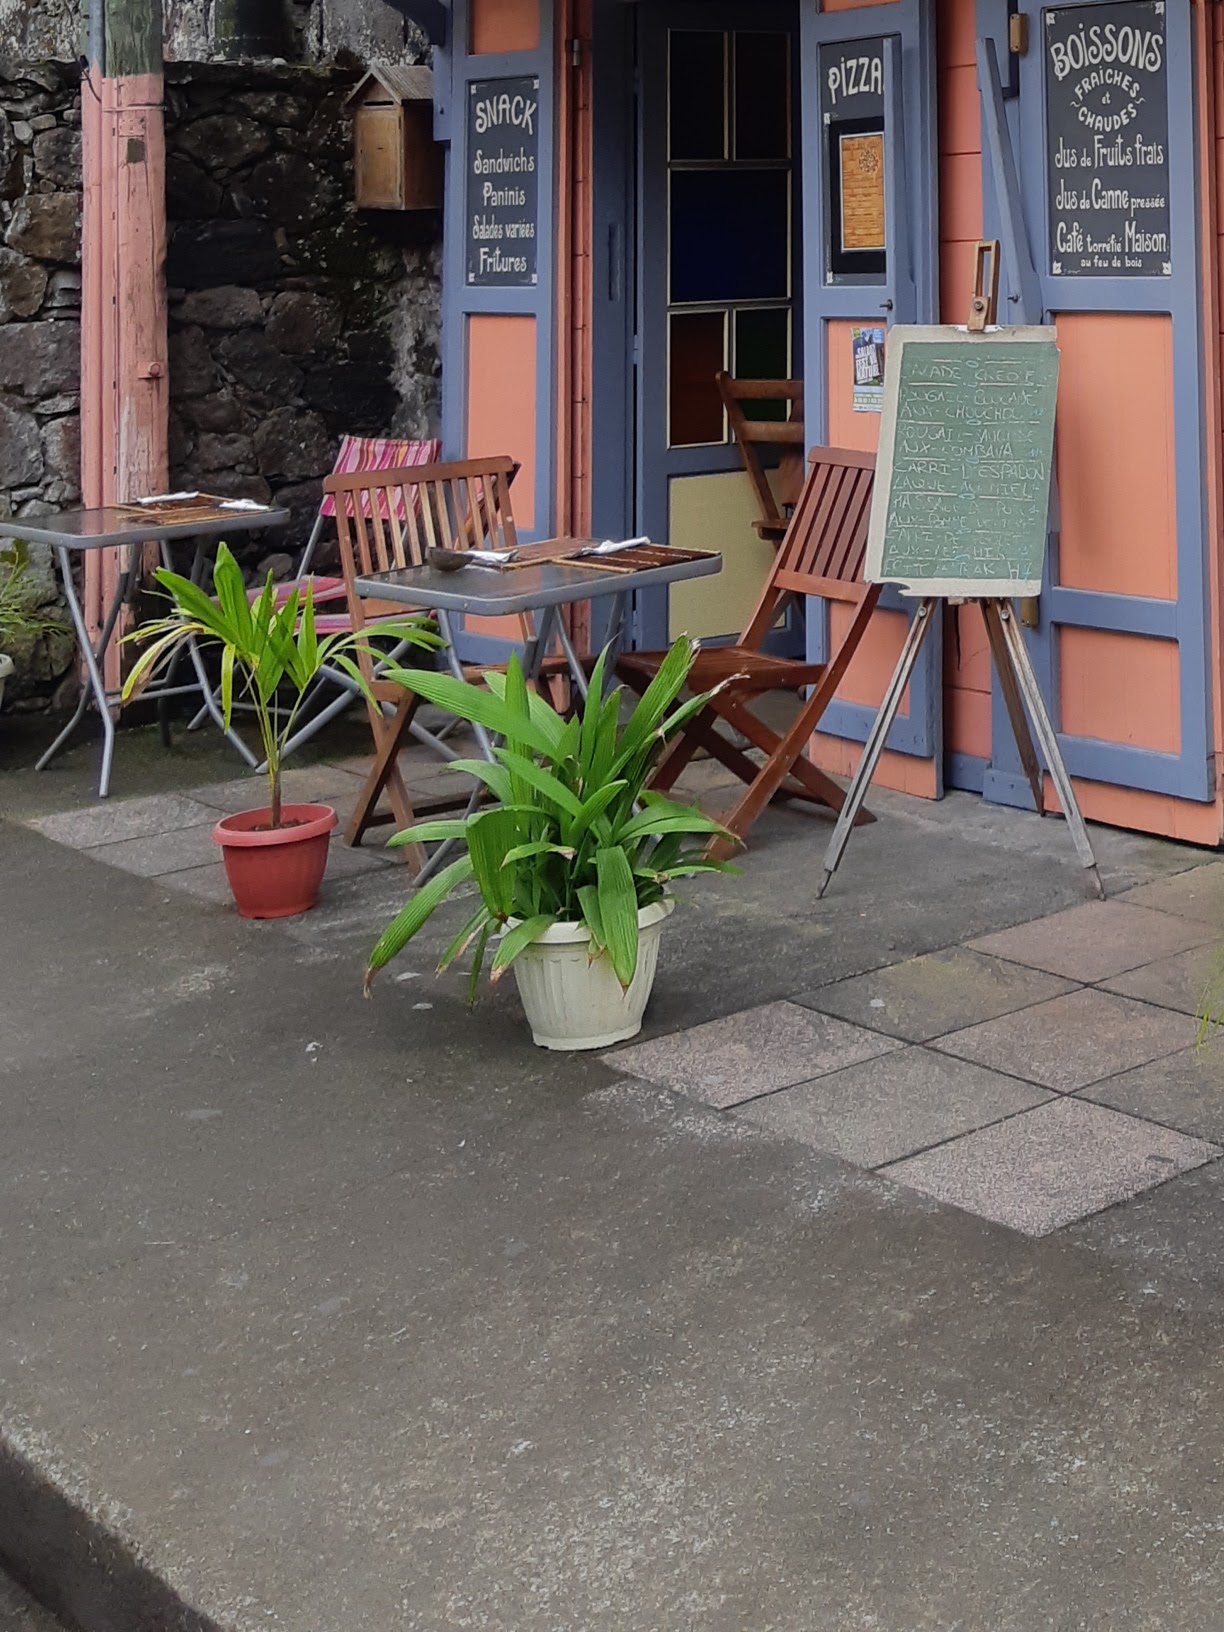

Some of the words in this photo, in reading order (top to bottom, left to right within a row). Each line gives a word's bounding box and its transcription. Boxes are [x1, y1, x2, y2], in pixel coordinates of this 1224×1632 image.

[828, 56, 885, 105] PiZZA
[1102, 91, 1111, 104] et
[475, 93, 537, 135] SNACK
[1079, 103, 1137, 132] CHAUDES
[474, 146, 535, 174] Sandwichs
[1055, 136, 1077, 168] Jus
[1080, 148, 1092, 167] de
[1094, 134, 1133, 169] Fruits
[1134, 134, 1164, 165] frais
[483, 181, 526, 206] Paninis
[1056, 178, 1078, 210] Jus
[1080, 190, 1090, 210] de
[1092, 178, 1129, 210] Canne
[1131, 194, 1165, 217] pressée
[472, 214, 503, 240] Salades
[505, 218, 535, 239] variées
[1057, 221, 1083, 253] Café
[1086, 234, 1122, 253] torréfié
[1125, 220, 1167, 253] Maison
[479, 246, 527, 275] Fritures
[1081, 259, 1091, 267] au
[1093, 255, 1109, 267] feu
[1112, 256, 1121, 267] de
[1125, 255, 1142, 267] bois
[894, 461, 950, 475] CARRI
